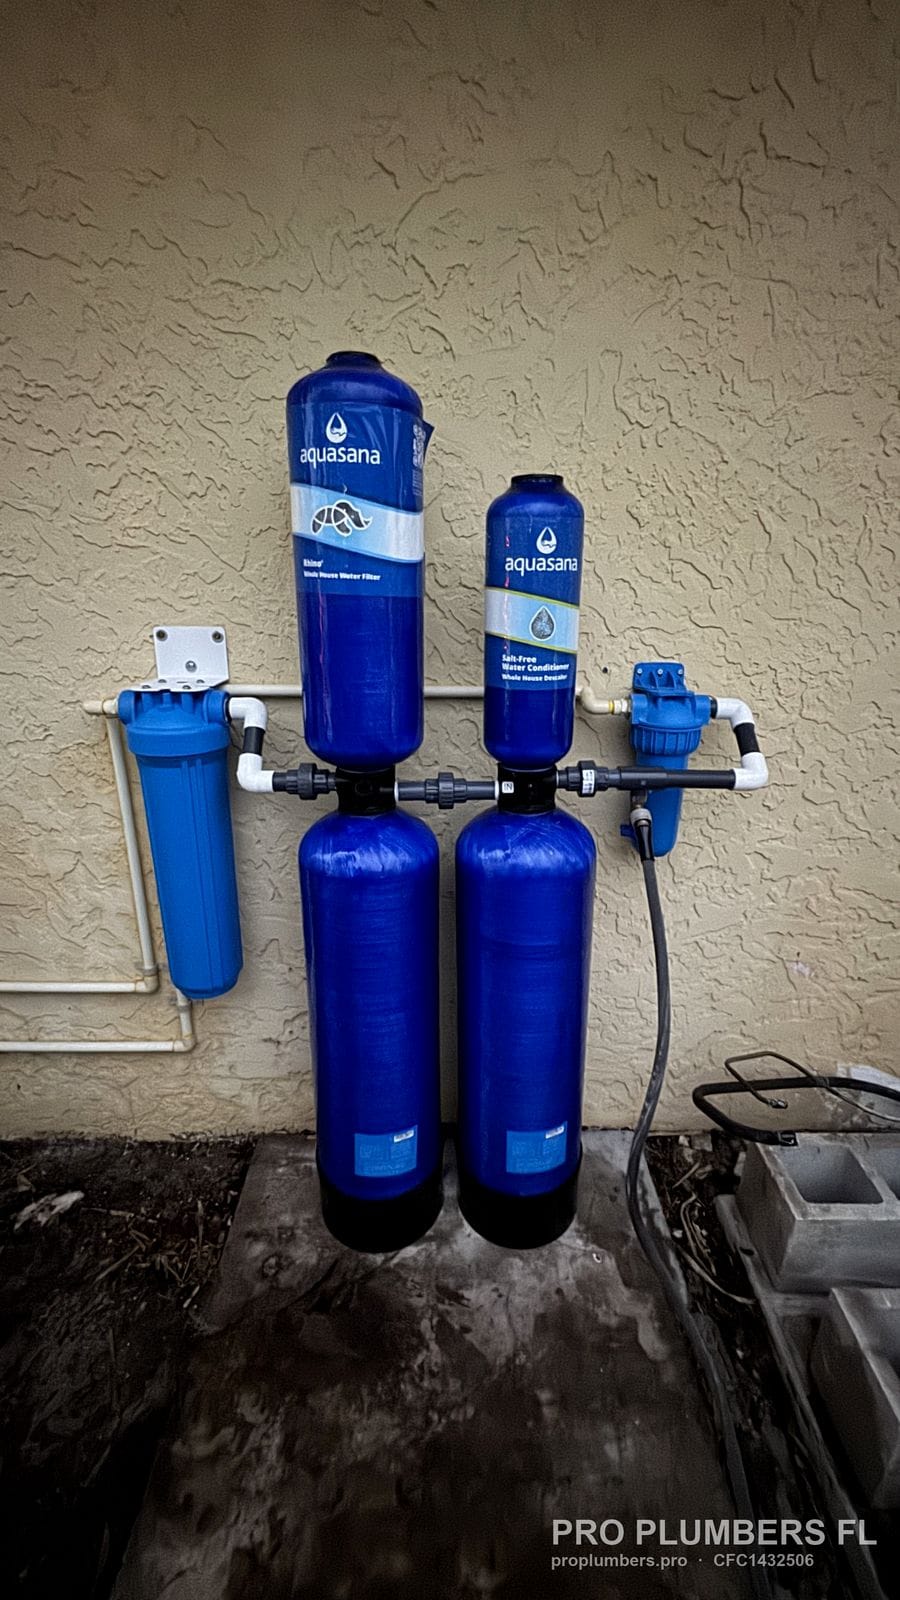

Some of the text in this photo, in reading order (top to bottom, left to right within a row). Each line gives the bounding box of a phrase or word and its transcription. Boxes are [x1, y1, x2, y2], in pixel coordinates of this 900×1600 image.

[300, 446, 381, 469] aquasana
[505, 557, 578, 576] aquasana
[319, 571, 339, 579] House
[339, 572, 361, 580] Water
[362, 573, 381, 581] Filter
[502, 654, 537, 663] Salt-Free
[502, 662, 570, 672] Water Conditioner
[501, 673, 521, 681] Whole
[522, 674, 543, 682] House
